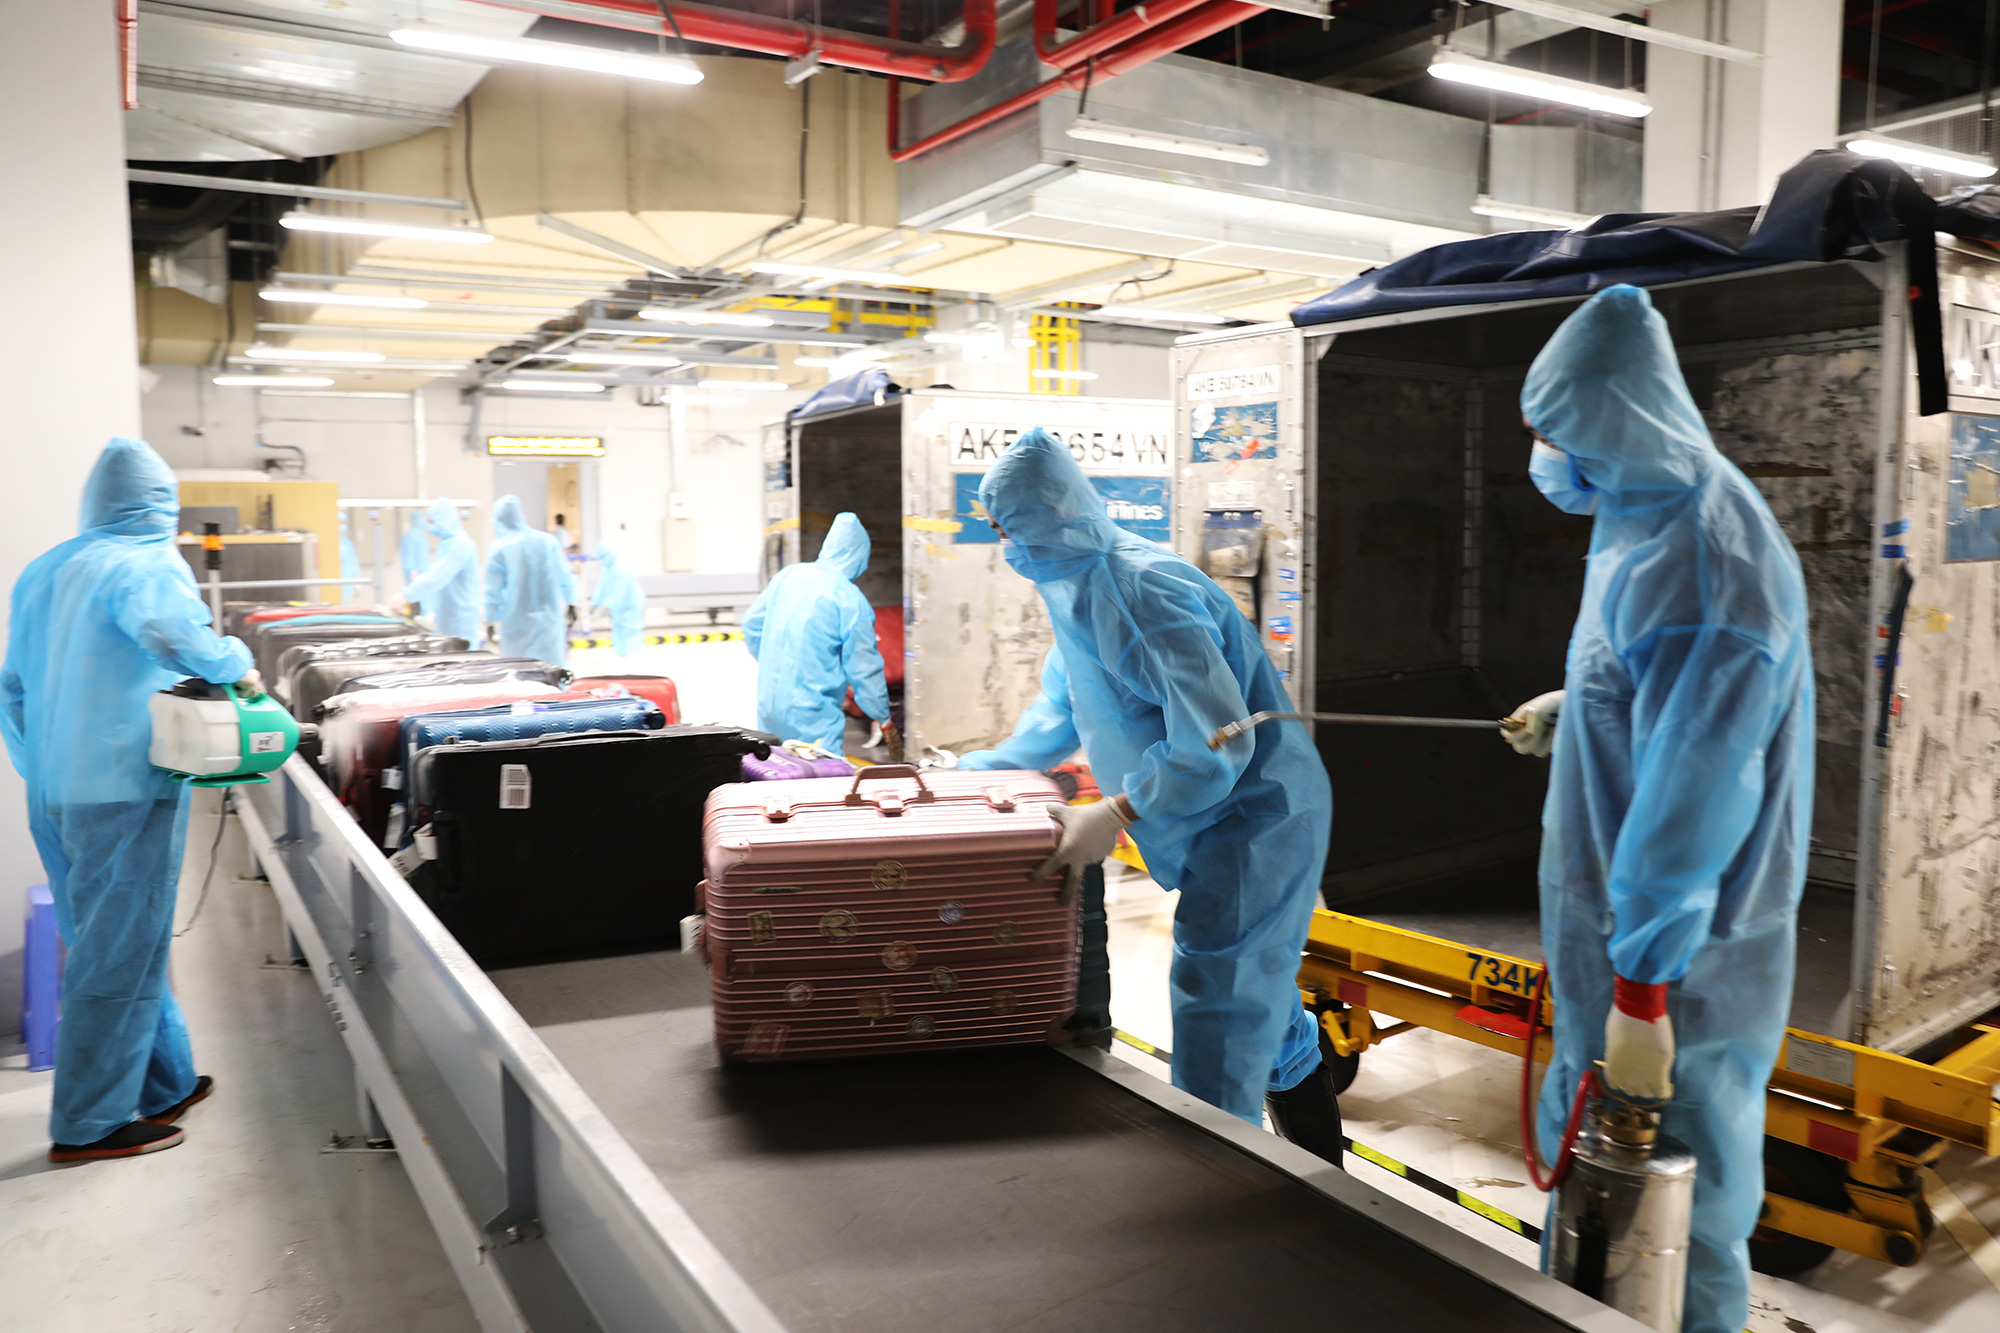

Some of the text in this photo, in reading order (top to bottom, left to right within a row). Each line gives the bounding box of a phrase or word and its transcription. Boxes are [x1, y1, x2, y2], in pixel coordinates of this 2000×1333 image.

[1956, 318, 2000, 389] AK
[1052, 431, 1124, 463] 654
[1131, 433, 1169, 464] VN
[1466, 951, 1553, 1001] 734K
